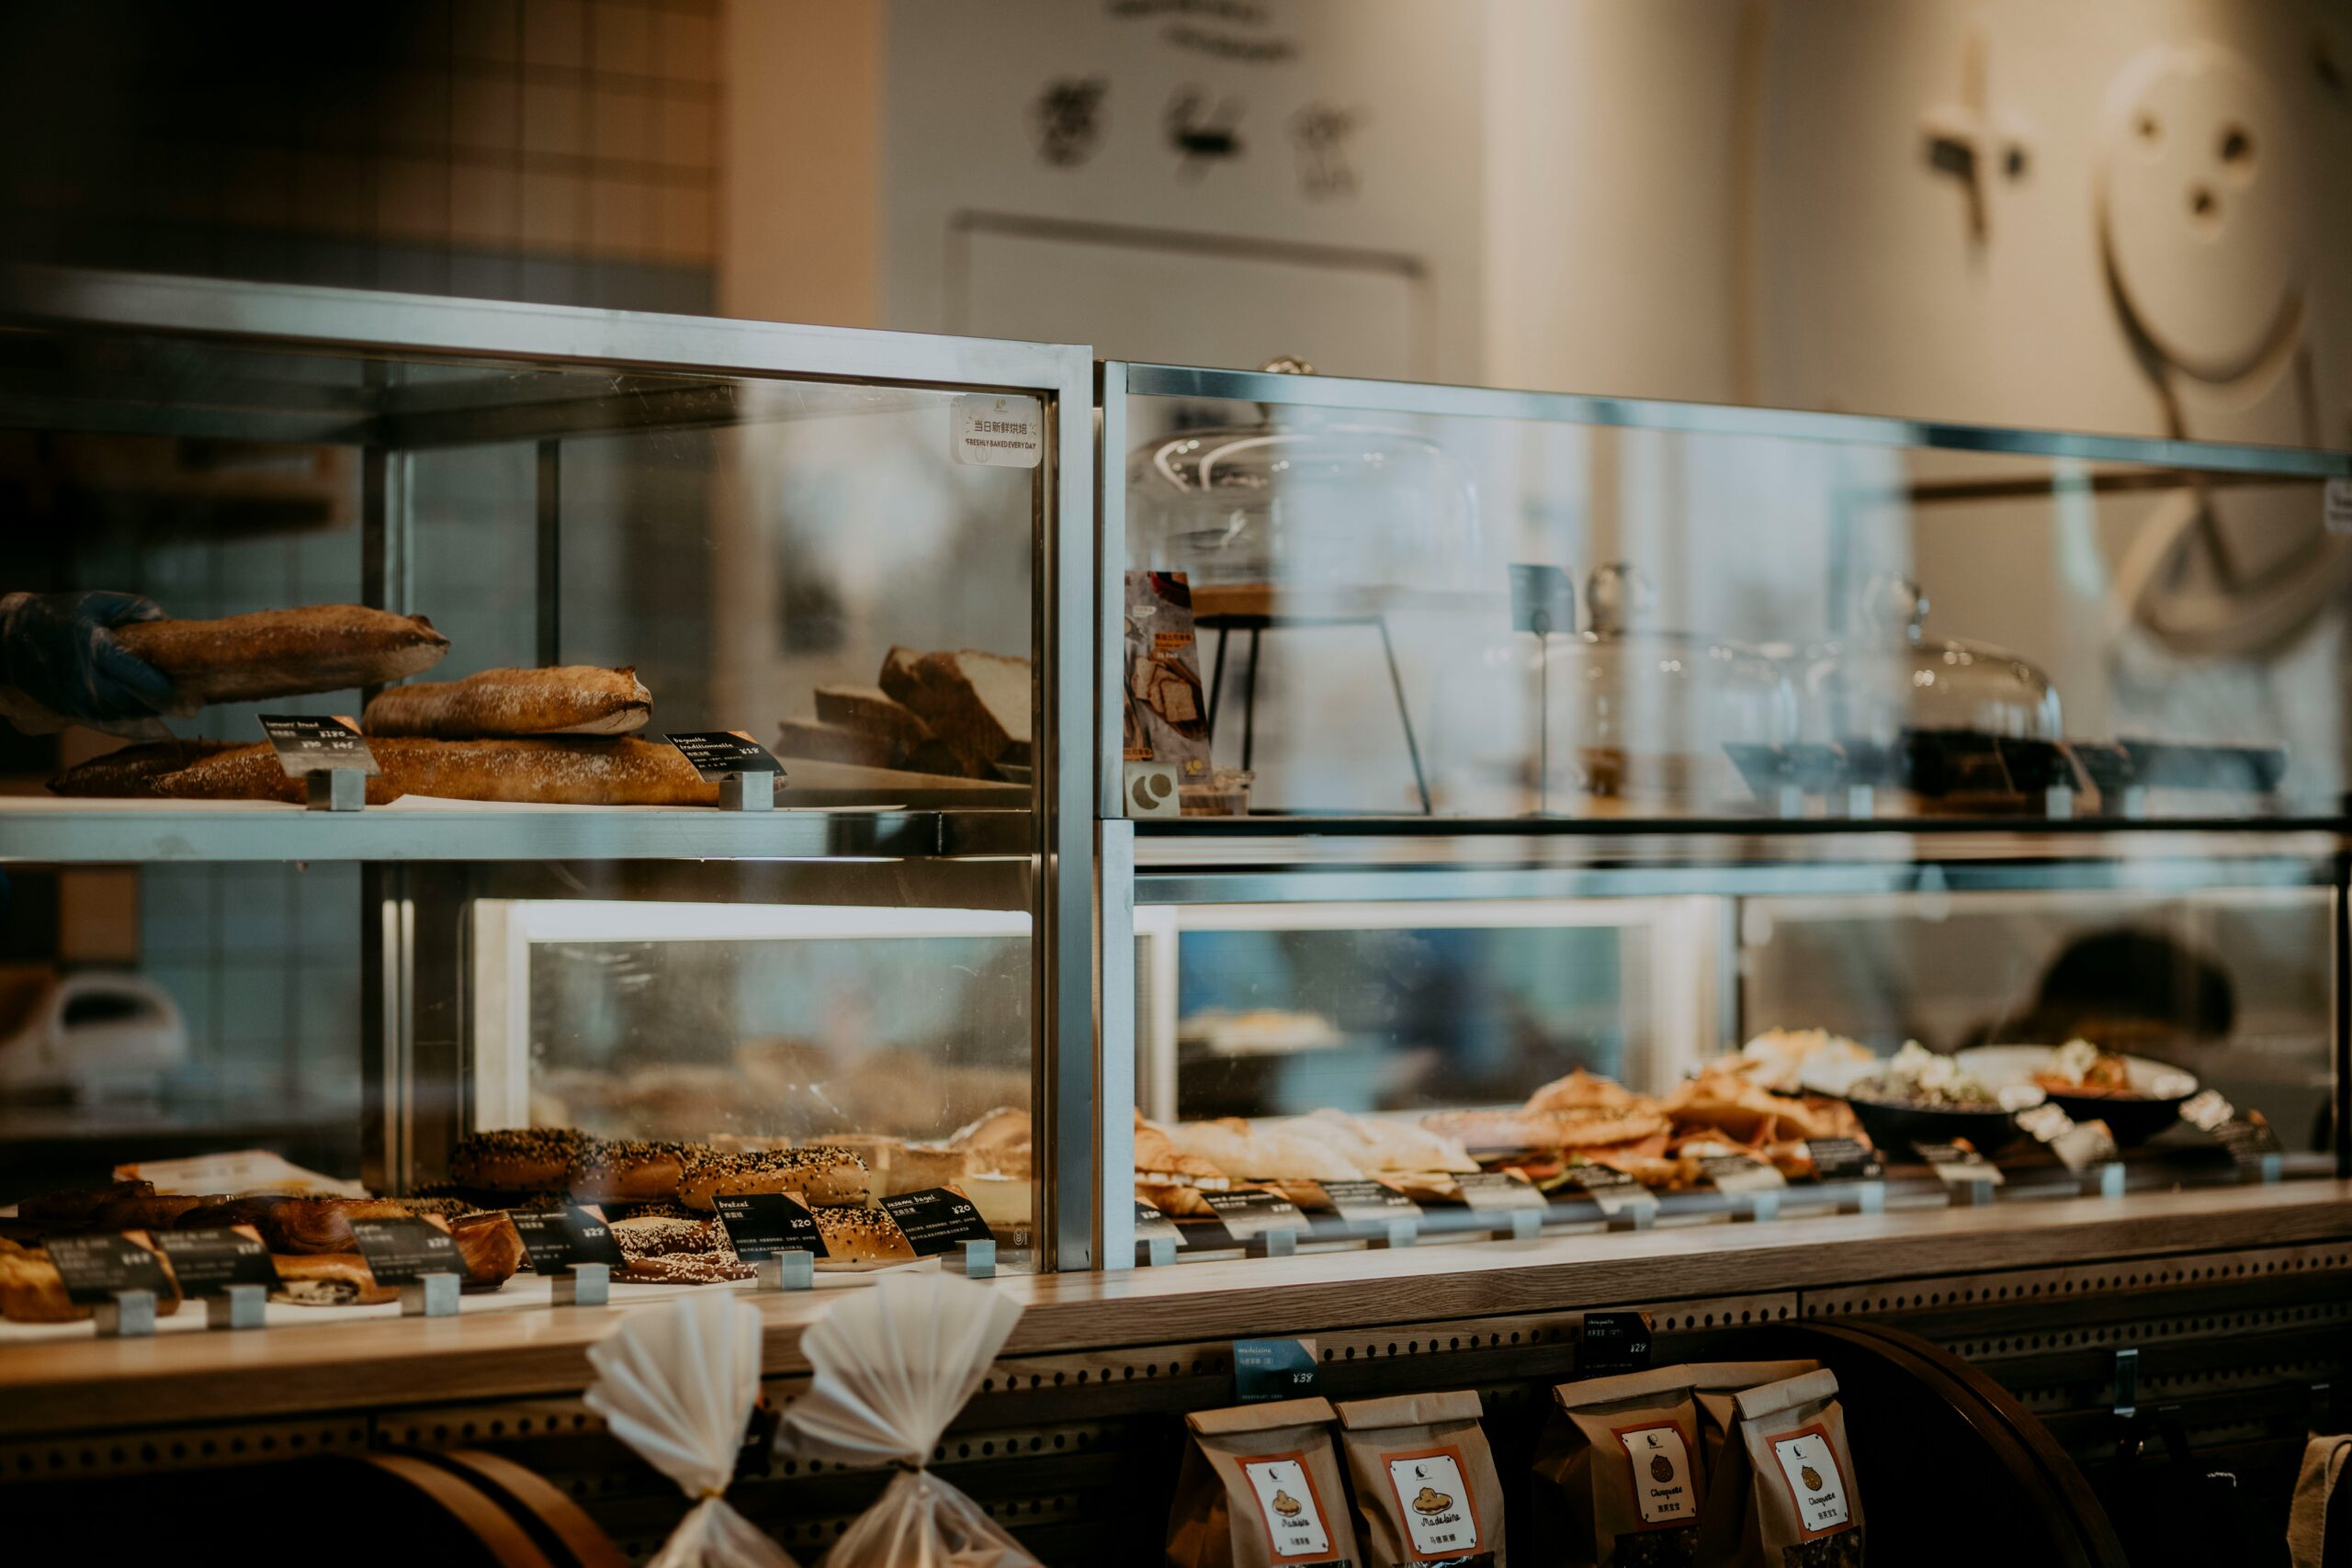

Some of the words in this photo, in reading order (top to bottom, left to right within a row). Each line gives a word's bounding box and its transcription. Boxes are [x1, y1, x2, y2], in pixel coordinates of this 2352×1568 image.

[974, 420, 1027, 434] 当日新鲜烘焙
[966, 438, 989, 447] FRESHLY
[990, 440, 1009, 448] BAKED
[1024, 442, 1036, 450] DAY
[718, 1200, 750, 1209] bretzel
[887, 1199, 913, 1208] sesame
[913, 1193, 936, 1203] bagel
[951, 1204, 971, 1214] ¥20
[790, 1219, 811, 1229] ¥20
[1293, 1372, 1314, 1384] ¥38
